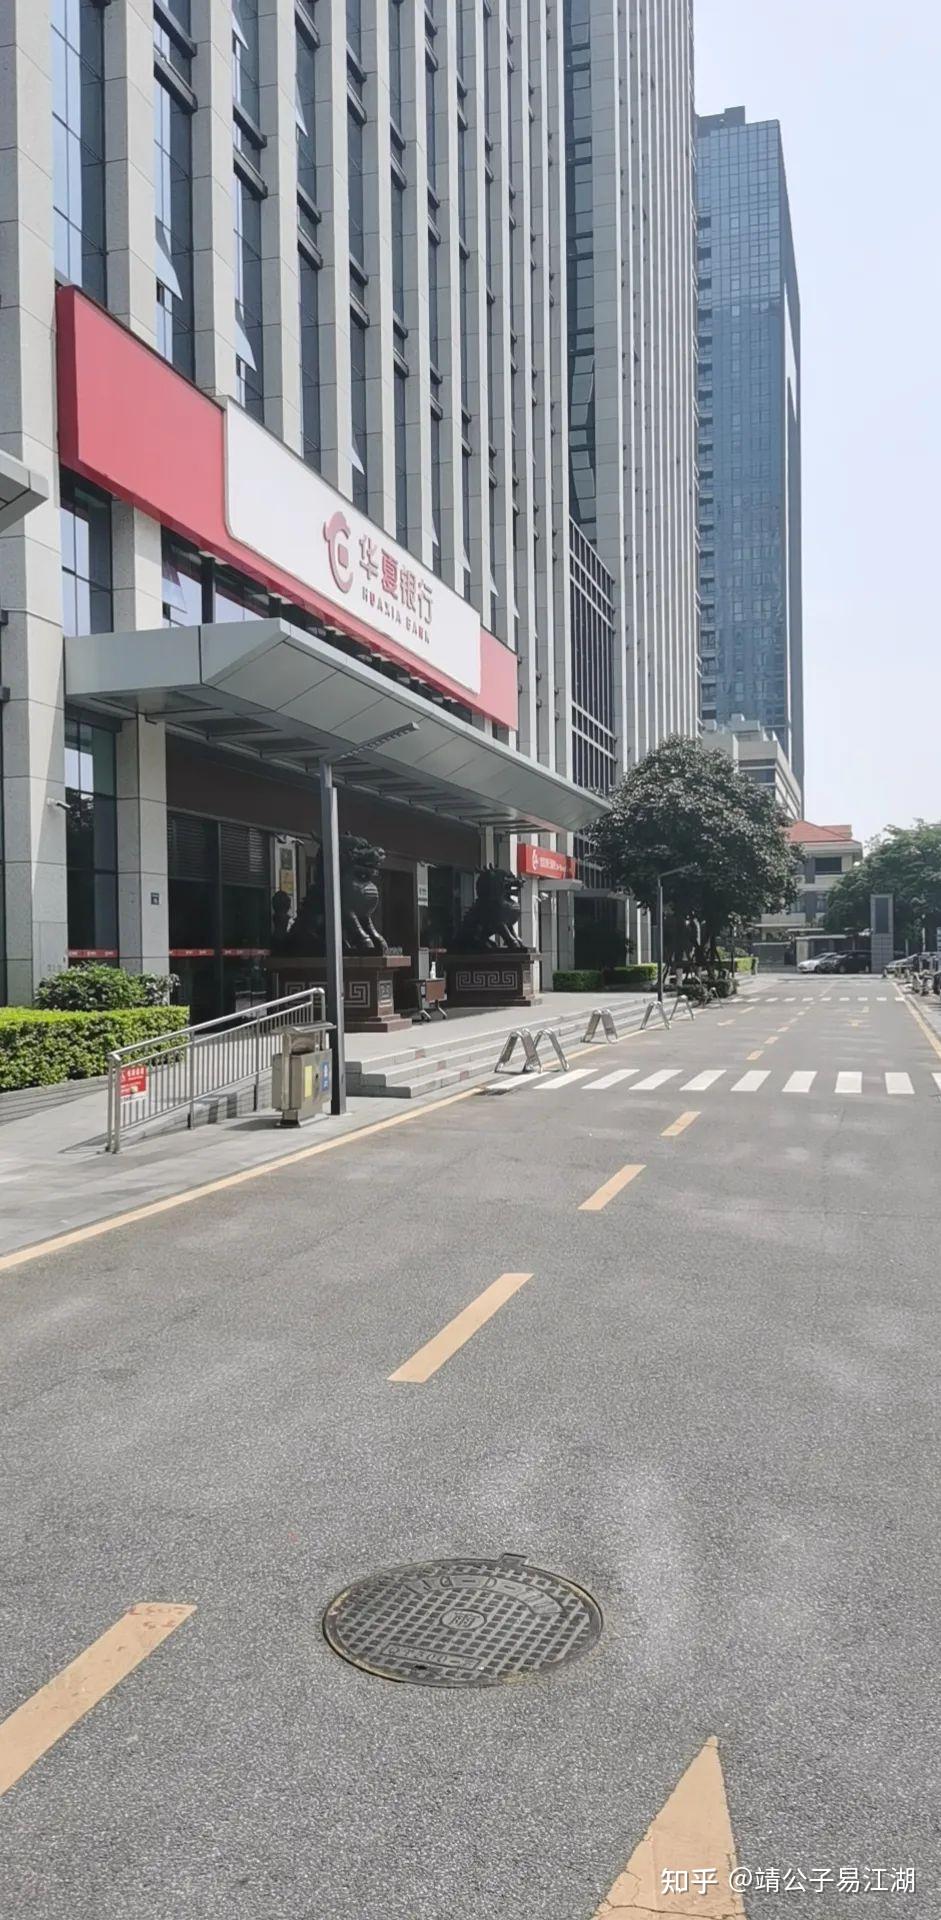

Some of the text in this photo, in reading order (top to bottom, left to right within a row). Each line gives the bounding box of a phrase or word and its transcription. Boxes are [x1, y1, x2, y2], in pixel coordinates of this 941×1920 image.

[358, 534, 433, 625] 华夏银行
[361, 586, 430, 644] HUAXIA BANK
